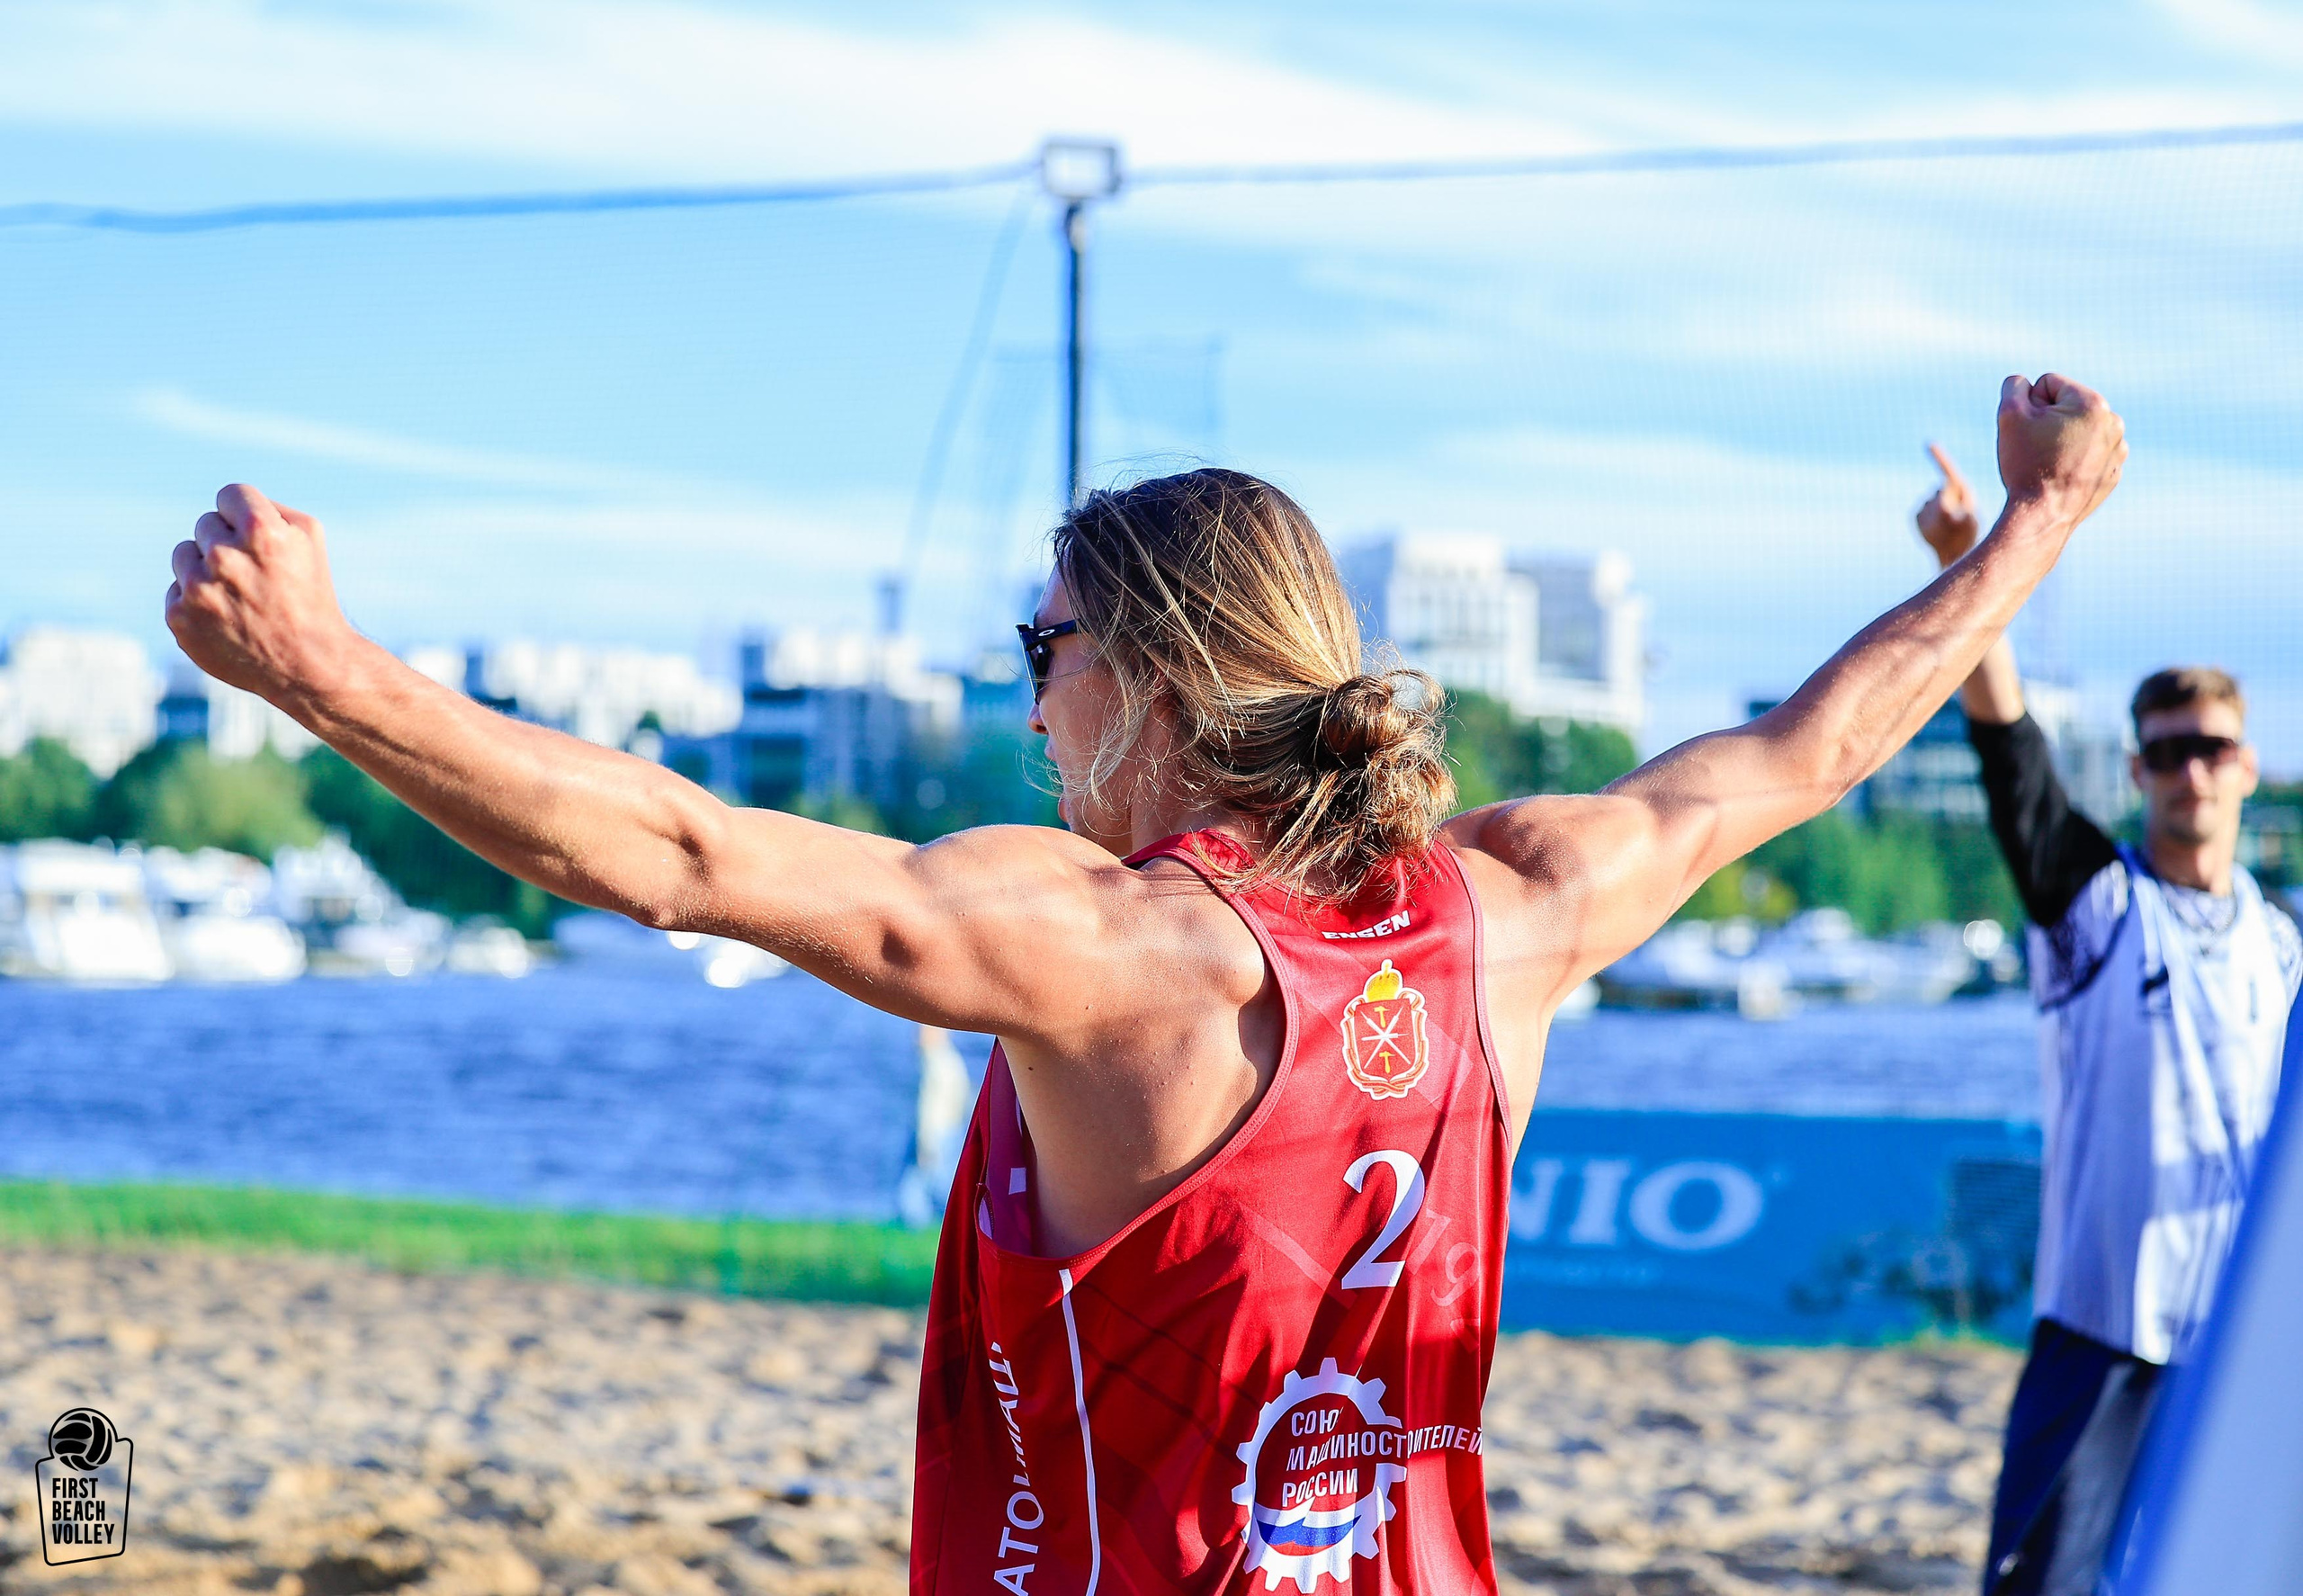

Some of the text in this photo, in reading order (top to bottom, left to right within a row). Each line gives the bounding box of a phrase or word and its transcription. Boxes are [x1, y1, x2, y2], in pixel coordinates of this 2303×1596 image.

[1341, 1149, 1426, 1290] 2
[1291, 1406, 1344, 1437] СОЮ
[1286, 1424, 1483, 1471] МАШИНОСТОИТЕЛЕЙ
[1282, 1468, 1358, 1508] РОССИИ
